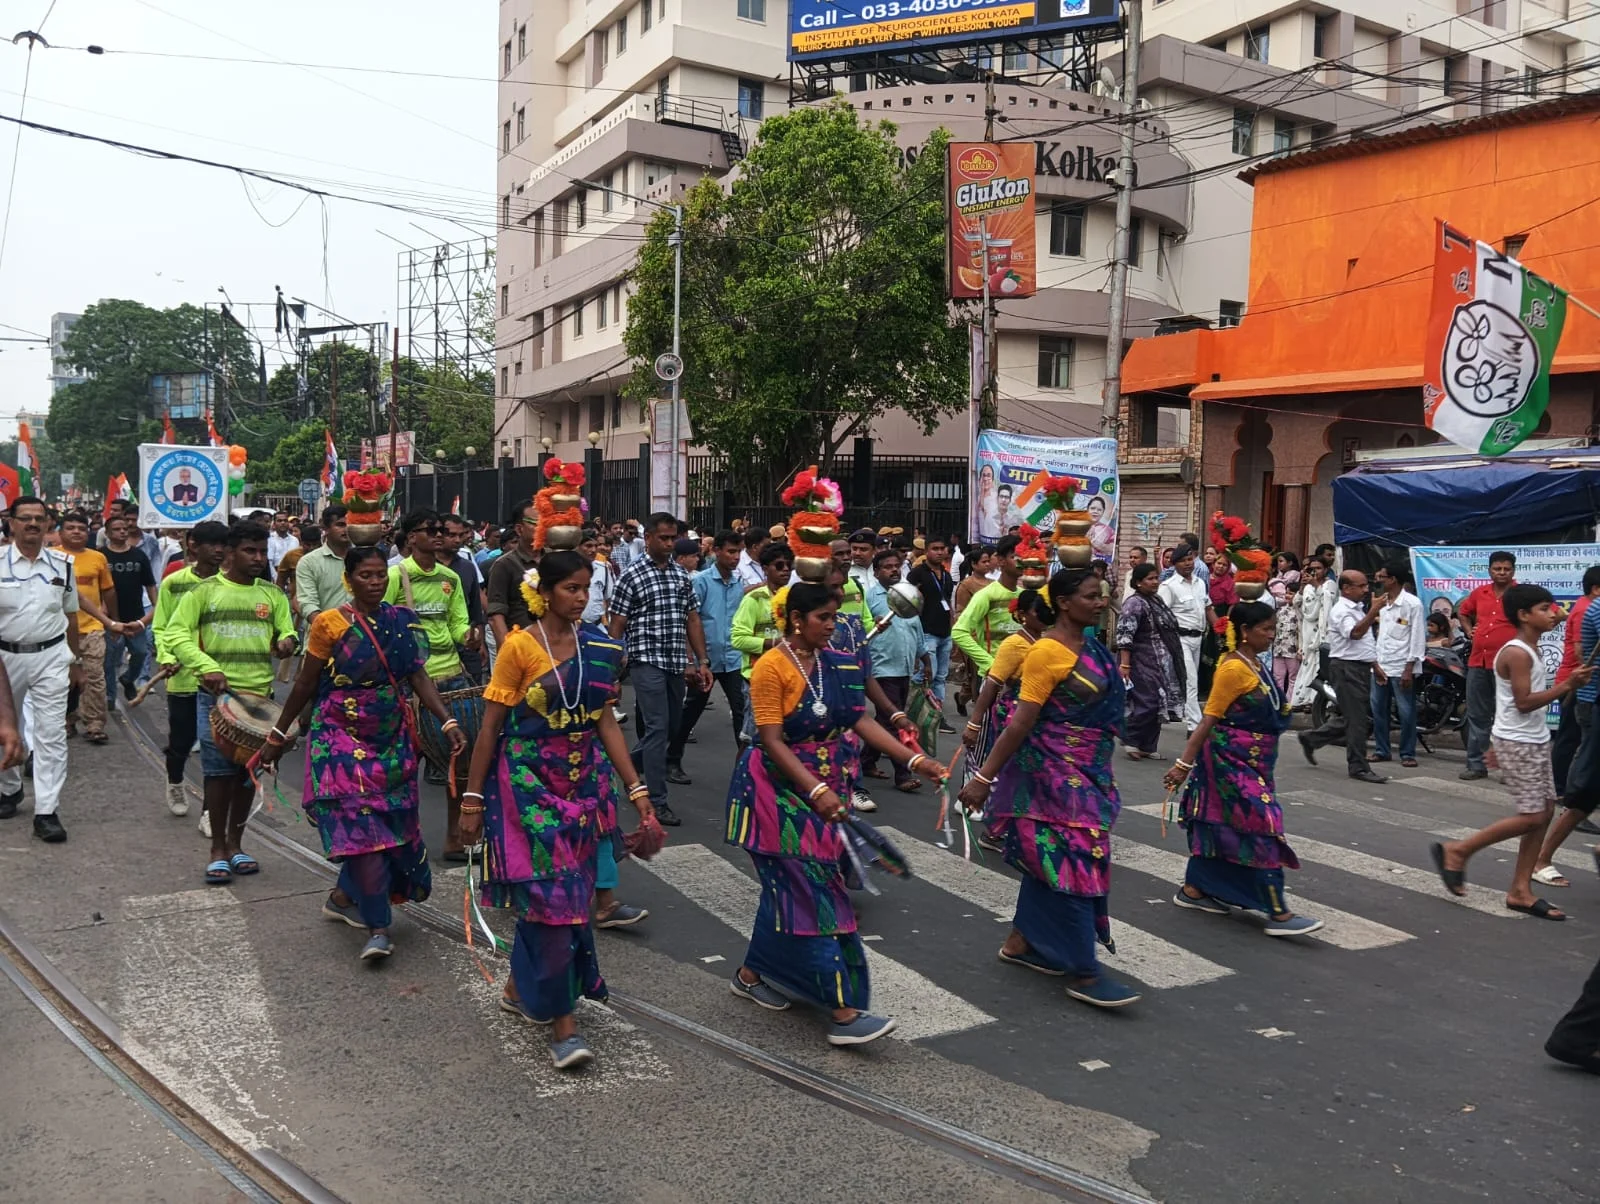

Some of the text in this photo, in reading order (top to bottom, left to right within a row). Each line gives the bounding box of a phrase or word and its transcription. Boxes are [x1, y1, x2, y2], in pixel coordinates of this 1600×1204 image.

[800, 10, 837, 27] Call
[805, 8, 1020, 42] INSTITUTE OF NEUROSCIENCES KOLKATA
[798, 39, 844, 52] NEURO-CARE
[845, 38, 855, 47] AT
[874, 34, 893, 43] VERY
[895, 32, 913, 41] BEST
[920, 26, 942, 37] WITH
[943, 26, 949, 34] A
[951, 20, 991, 33] PERSONAL
[993, 18, 1020, 28] TOUCH
[957, 178, 1029, 207] GluKon
[963, 201, 994, 214] INSTANT
[996, 195, 1025, 206] ENERGY
[1423, 578, 1452, 592] ममता
